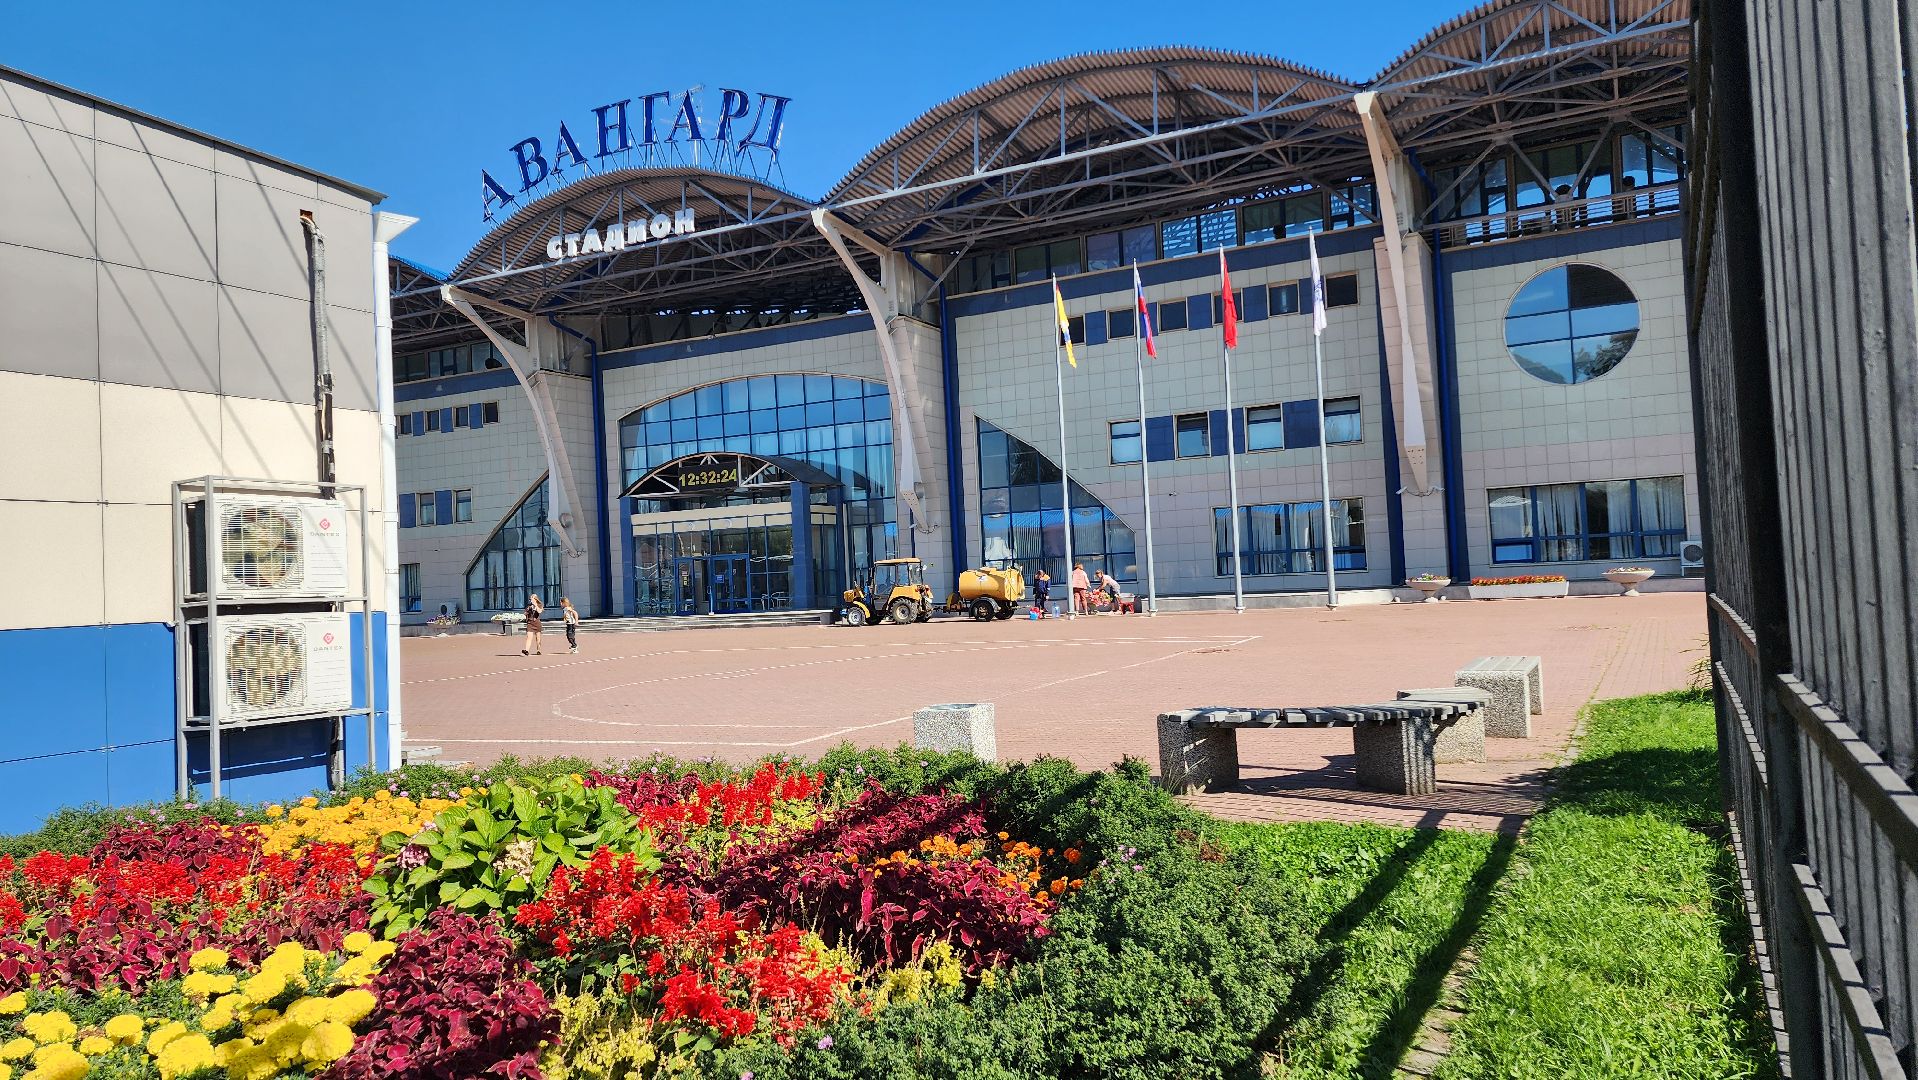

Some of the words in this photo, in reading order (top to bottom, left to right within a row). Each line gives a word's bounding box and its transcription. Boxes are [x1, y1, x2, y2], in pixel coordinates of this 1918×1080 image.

[481, 87, 793, 223] АВАНГАРД
[546, 207, 696, 259] СТАДИОН
[678, 468, 737, 487] 12:32:24
